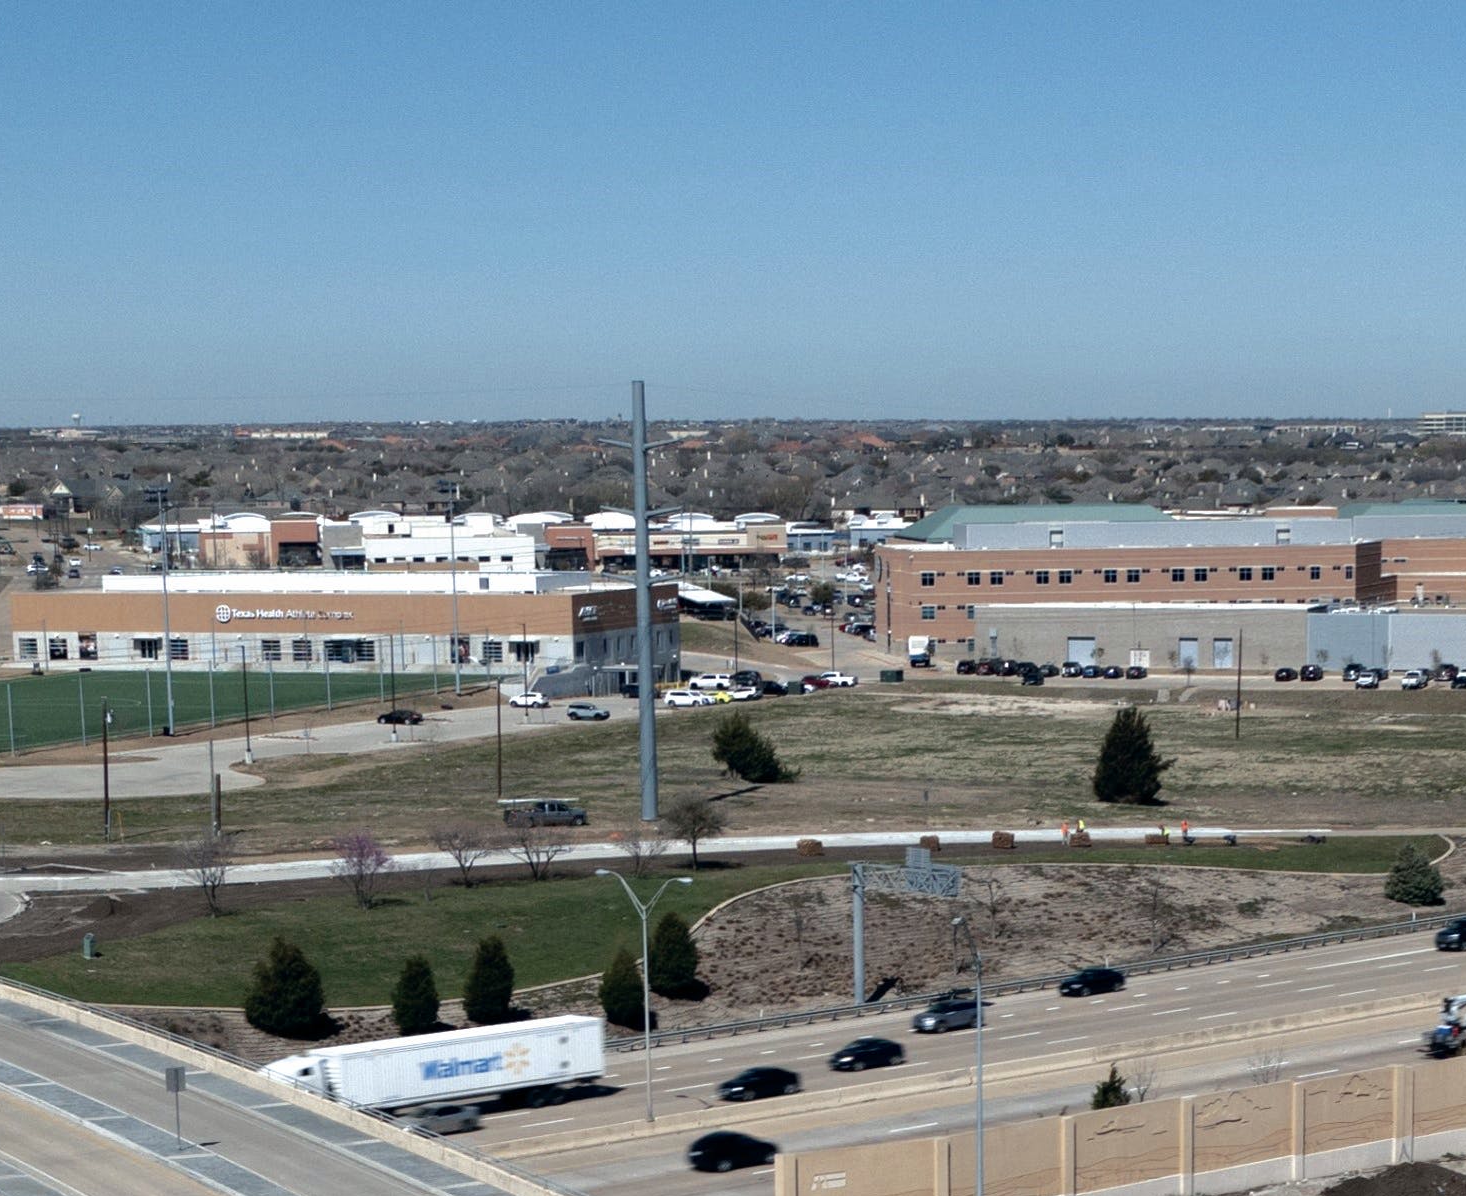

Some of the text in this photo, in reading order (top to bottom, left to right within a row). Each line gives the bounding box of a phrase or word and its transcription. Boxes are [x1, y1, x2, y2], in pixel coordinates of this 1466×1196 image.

[232, 609, 255, 619] Texas
[256, 609, 283, 618] Health
[420, 1051, 503, 1080] Walmart
